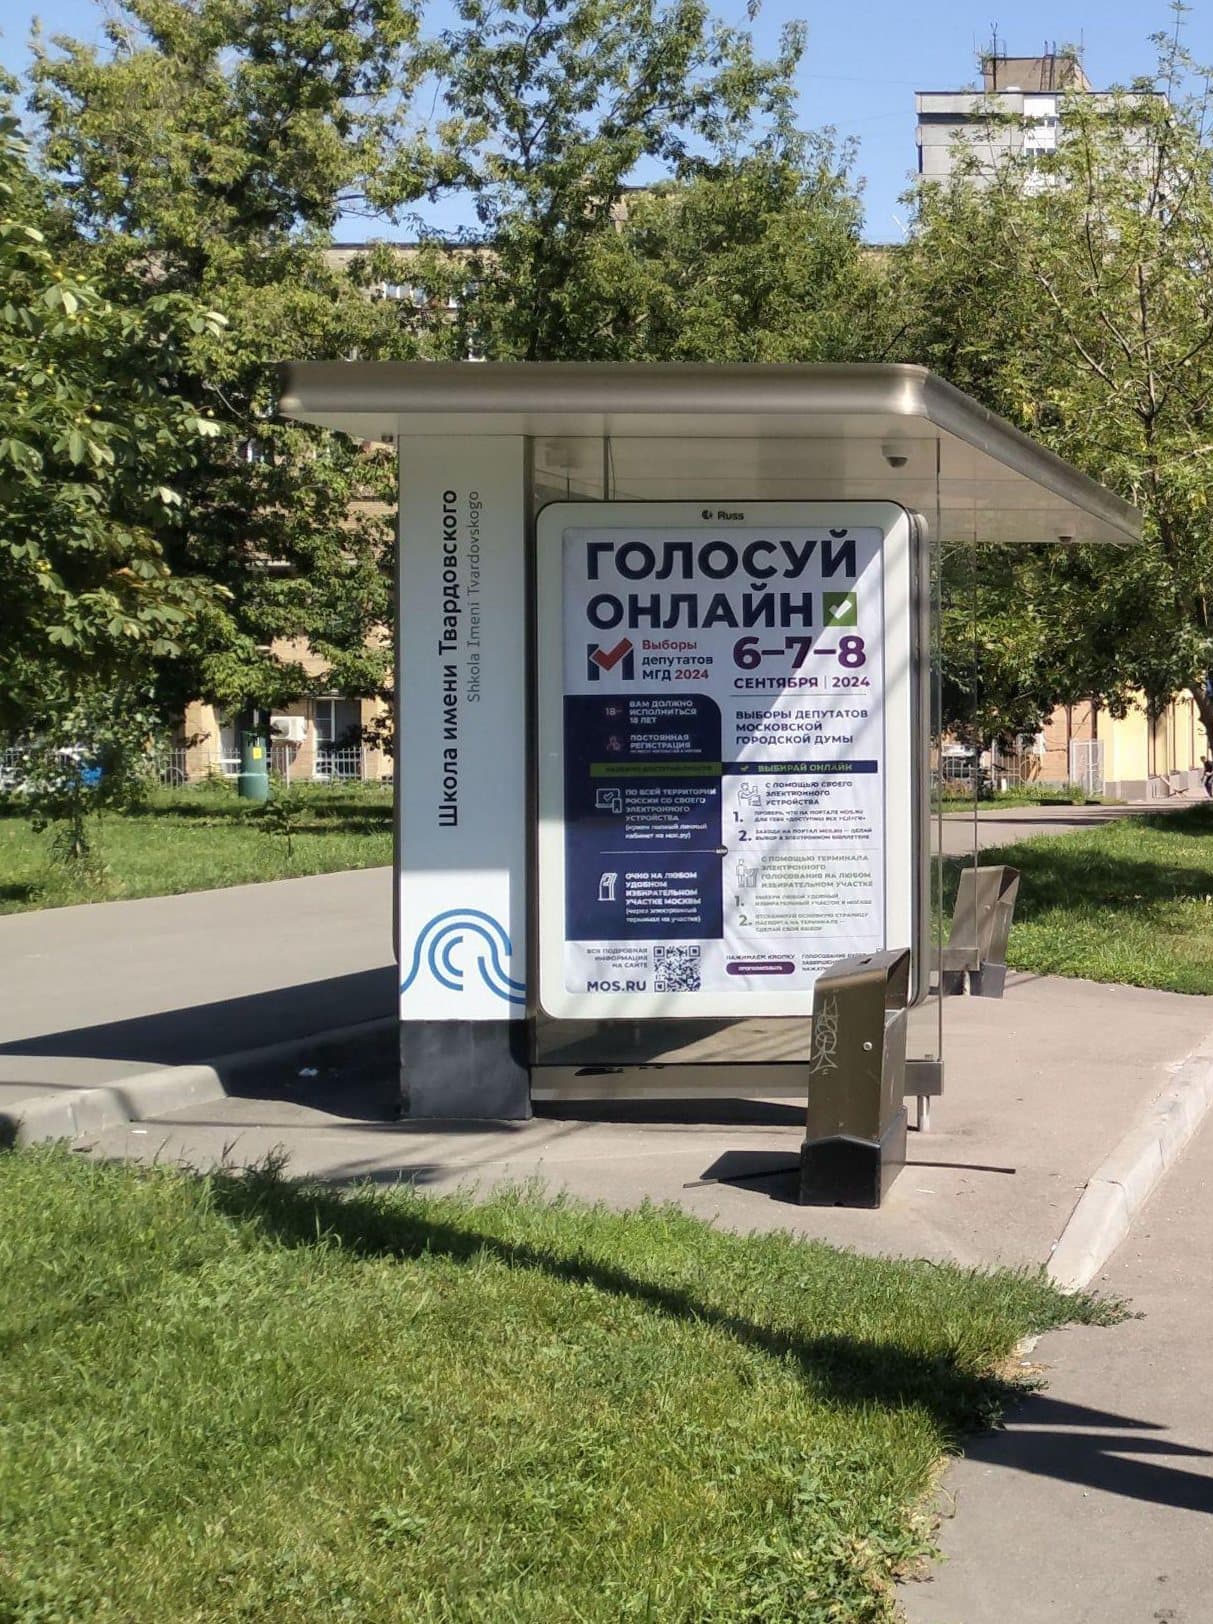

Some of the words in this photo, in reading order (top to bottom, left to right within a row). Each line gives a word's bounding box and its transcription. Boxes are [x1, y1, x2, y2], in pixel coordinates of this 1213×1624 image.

[717, 511, 744, 520] Russ
[467, 491, 483, 596] Tvardovskogo
[587, 528, 856, 580] ГОЛОСУЙ
[438, 490, 462, 656] Твардовского
[586, 583, 813, 630] ОНЛАЙН
[467, 602, 480, 648] Imeni
[642, 639, 697, 651] Выборы
[642, 655, 714, 666] депутатов
[467, 653, 480, 703] Shkola
[642, 669, 672, 683] МГД
[674, 669, 709, 680] 2024
[733, 677, 819, 690] СЕНТЯБРЯ
[832, 676, 871, 688] 2024
[443, 665, 458, 740] имени
[651, 700, 693, 709] ДОЛЖНО
[629, 708, 697, 716] ИСПОЛНИТЬСЯ
[736, 710, 792, 720] ВЫБОРЫ
[795, 710, 869, 720] ДЕПУТАТОВ
[736, 722, 823, 732] МОСКОВСКОЙ
[736, 734, 811, 745] ГОРОДСКОЙ
[814, 735, 854, 745] ДУМЫ
[630, 742, 691, 750] РЕГИСТРАЦИЯ
[757, 763, 807, 773] ВЫБИРАЙ
[809, 763, 853, 772] ОНЛАЙН
[439, 748, 458, 827] Школа
[733, 811, 744, 823] 1.
[738, 830, 752, 842] 2.
[738, 914, 752, 926] 2.
[587, 981, 646, 992] MOS.RU
